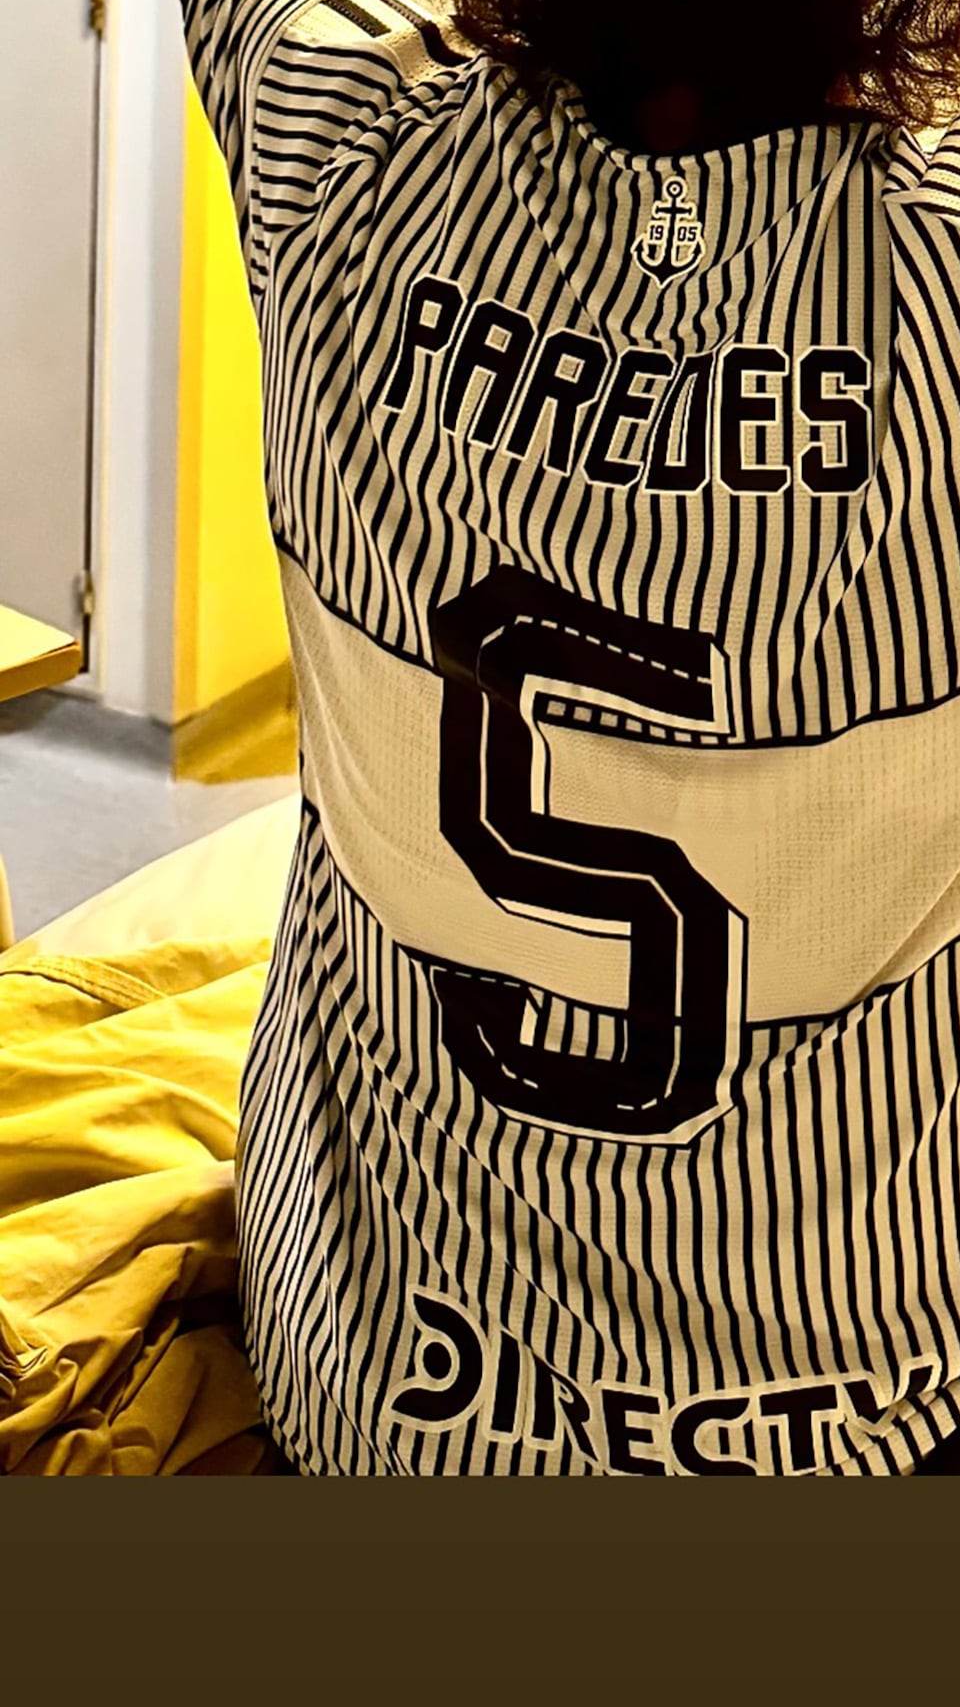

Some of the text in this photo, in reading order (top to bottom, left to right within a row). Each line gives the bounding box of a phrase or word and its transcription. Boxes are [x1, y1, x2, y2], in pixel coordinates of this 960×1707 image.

[649, 224, 698, 242] 19 05
[382, 273, 873, 495] PAREDES
[431, 562, 749, 1146] 5
